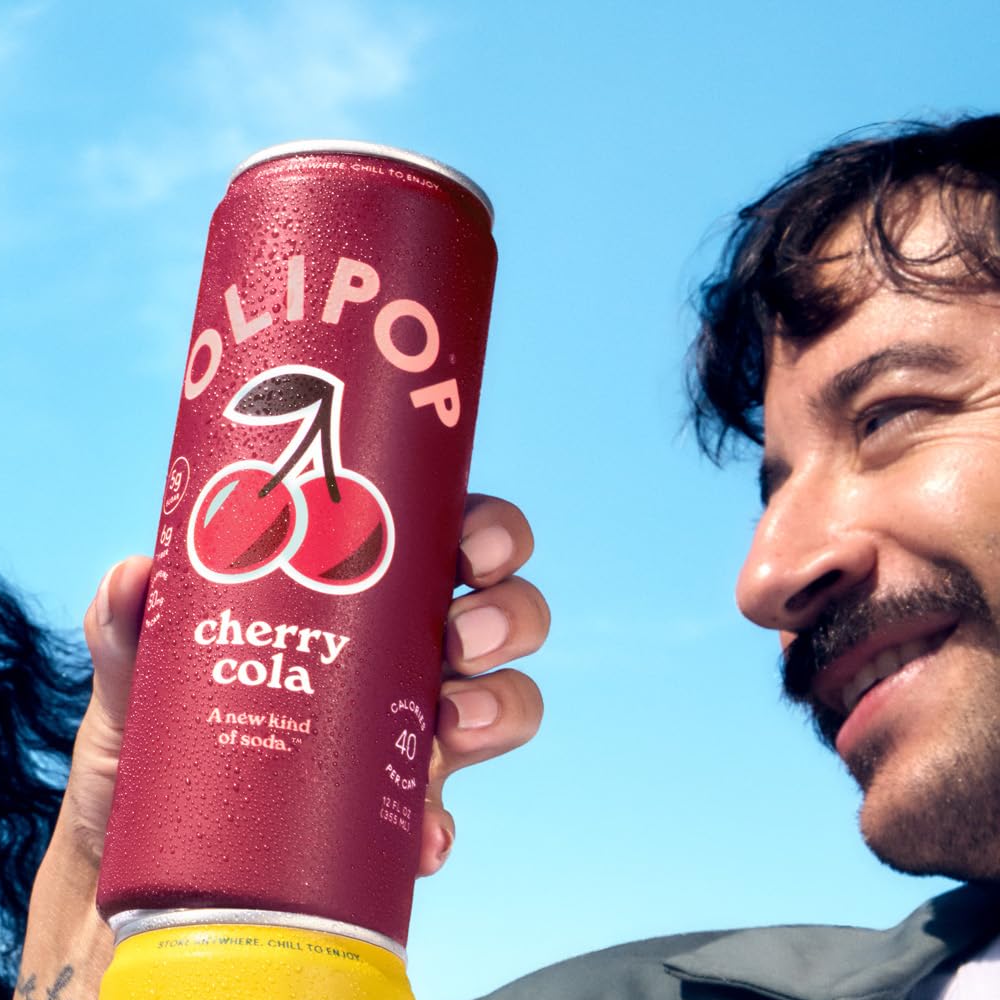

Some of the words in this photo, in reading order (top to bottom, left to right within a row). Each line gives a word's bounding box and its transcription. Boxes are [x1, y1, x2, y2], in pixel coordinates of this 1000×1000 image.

[352, 163, 385, 175] CHILL
[388, 167, 404, 179] TO
[184, 254, 462, 429] OLIPOP
[193, 608, 351, 664] cherry
[212, 653, 315, 695] cola
[206, 707, 222, 724] A
[225, 712, 266, 726] new
[268, 713, 311, 734] kind
[218, 729, 238, 745] of
[394, 729, 417, 760] 40
[385, 763, 401, 786] PER
[401, 777, 416, 790] CAN
[382, 795, 392, 808] 12
[267, 939, 303, 951] CHILL
[306, 943, 323, 954] TO
